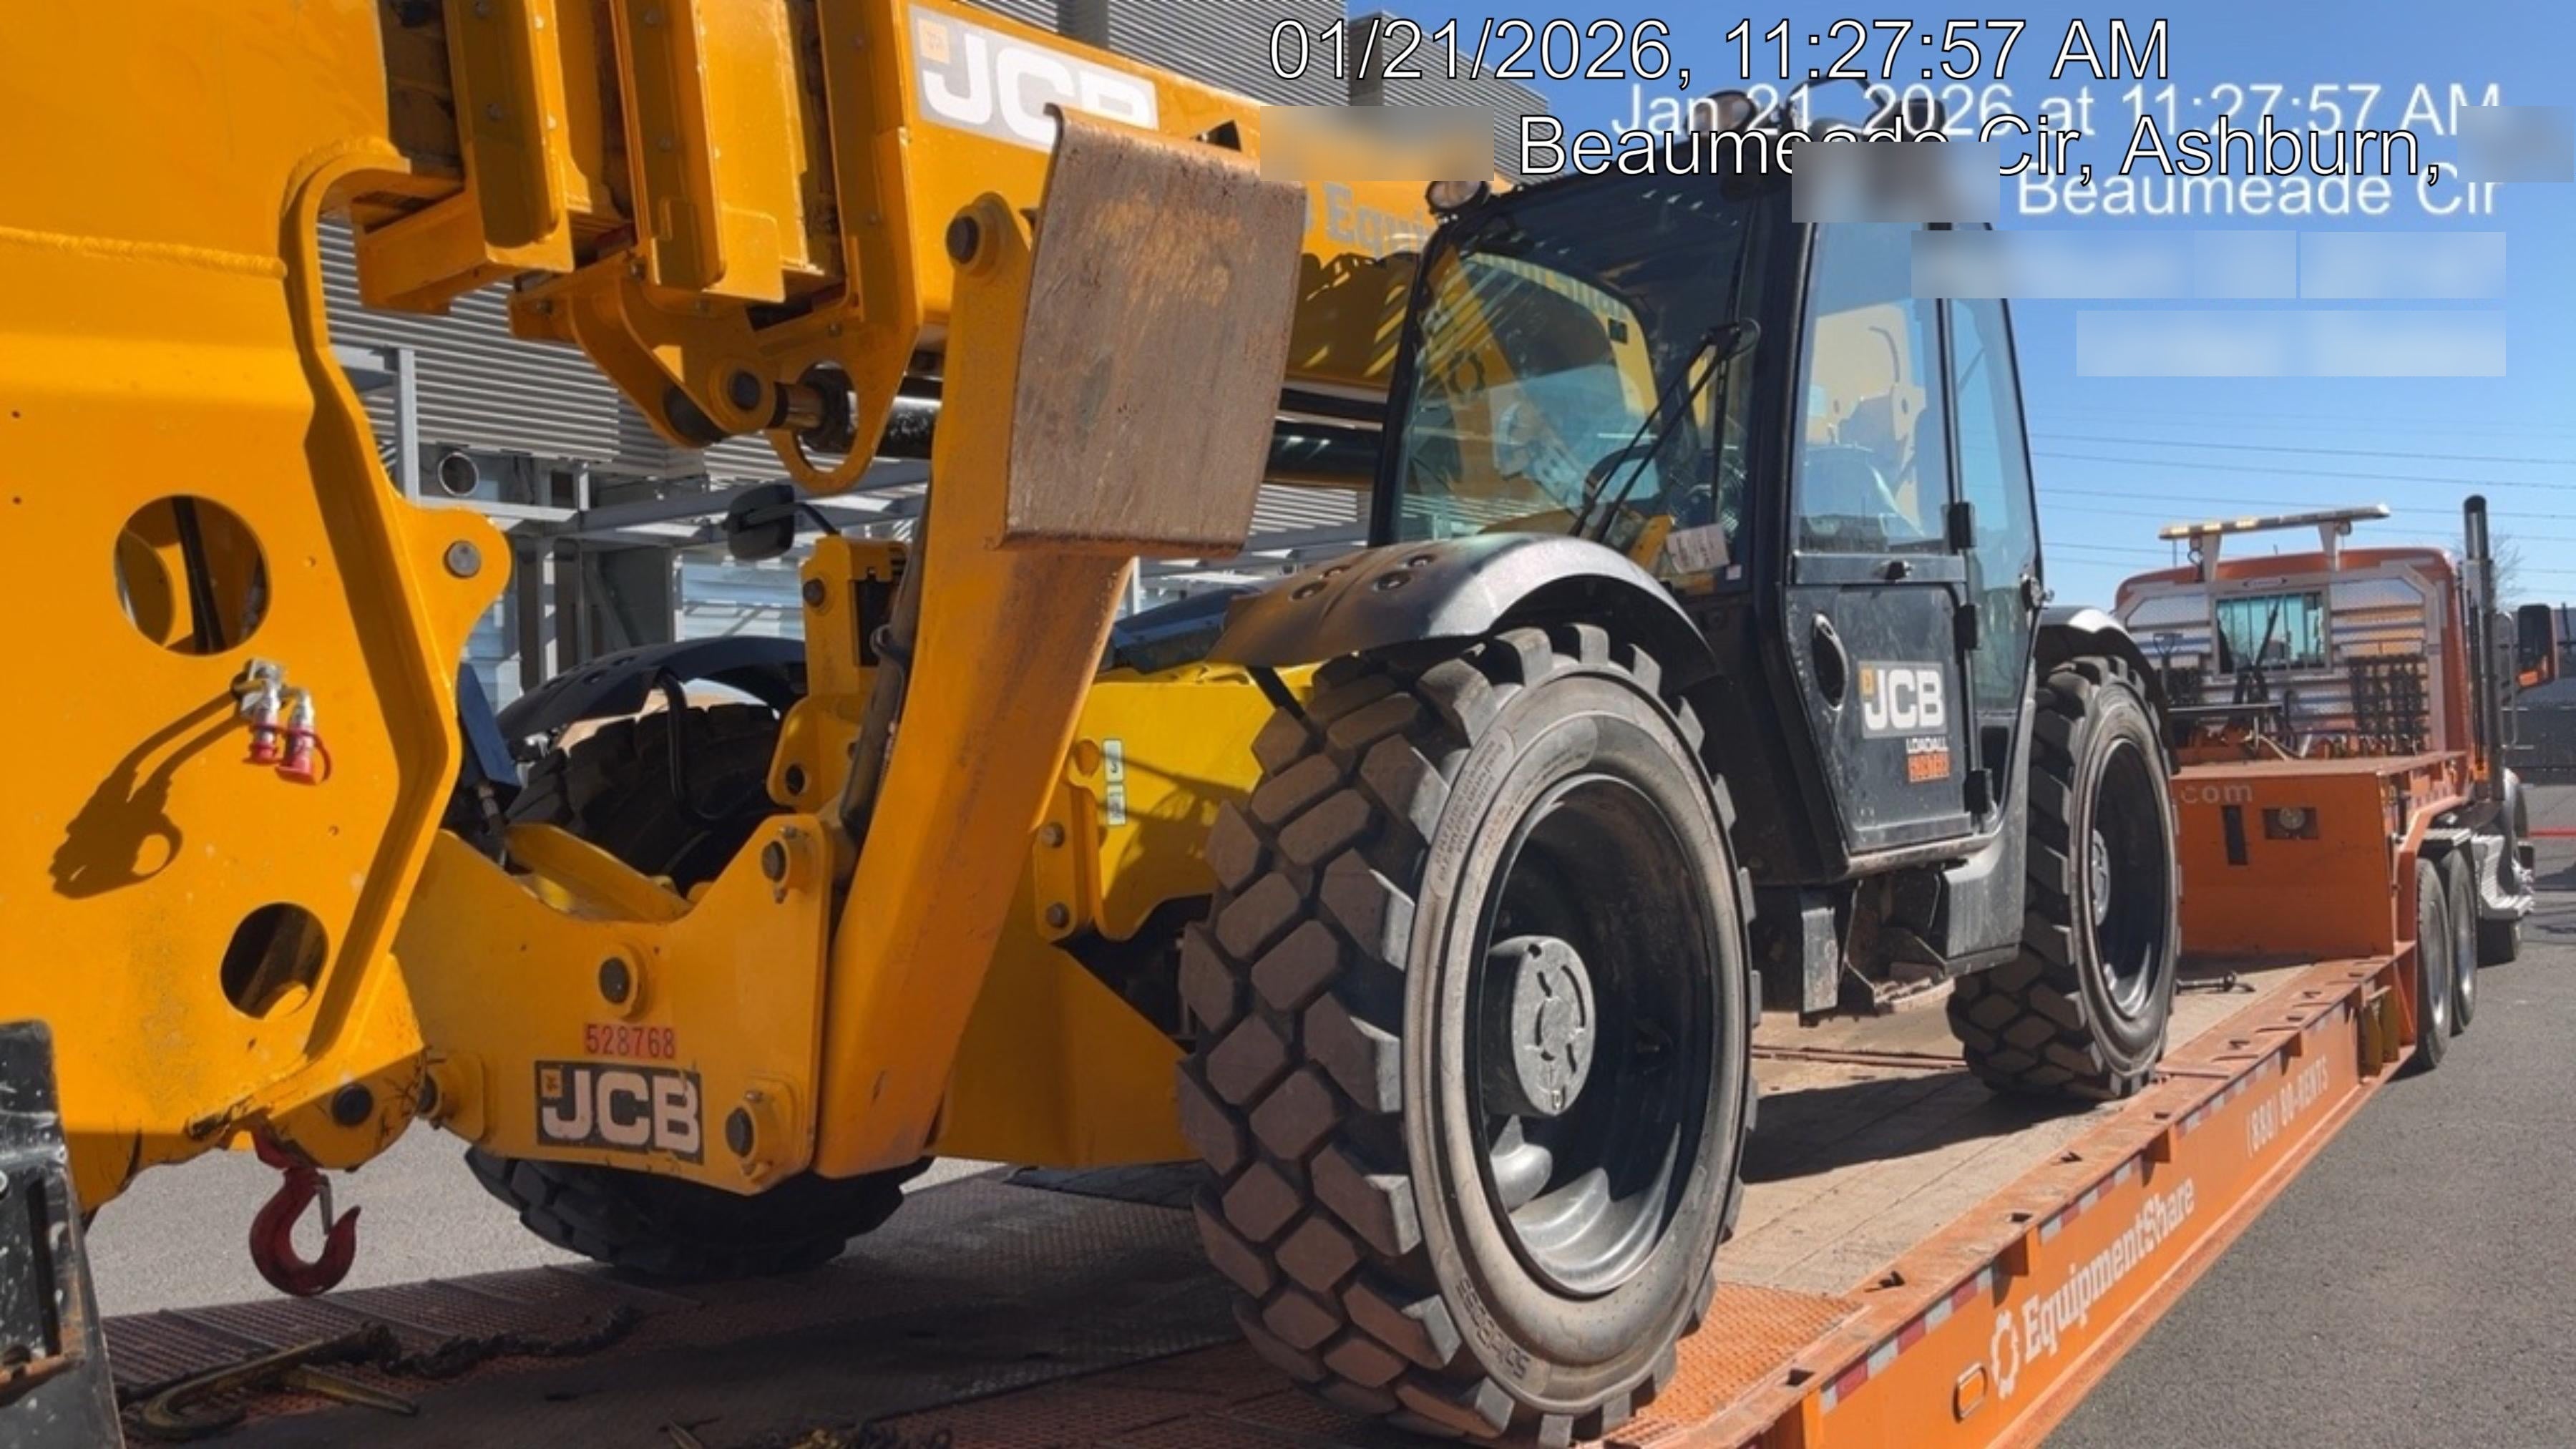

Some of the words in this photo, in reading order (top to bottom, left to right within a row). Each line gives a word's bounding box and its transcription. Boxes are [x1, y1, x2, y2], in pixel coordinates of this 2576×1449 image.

[921, 34, 1158, 143] JC
[1863, 668, 1946, 731] JCB
[585, 1023, 675, 1059] 528768
[542, 1069, 701, 1154] JCB
[2021, 1177, 2195, 1364] EquipmentShare
